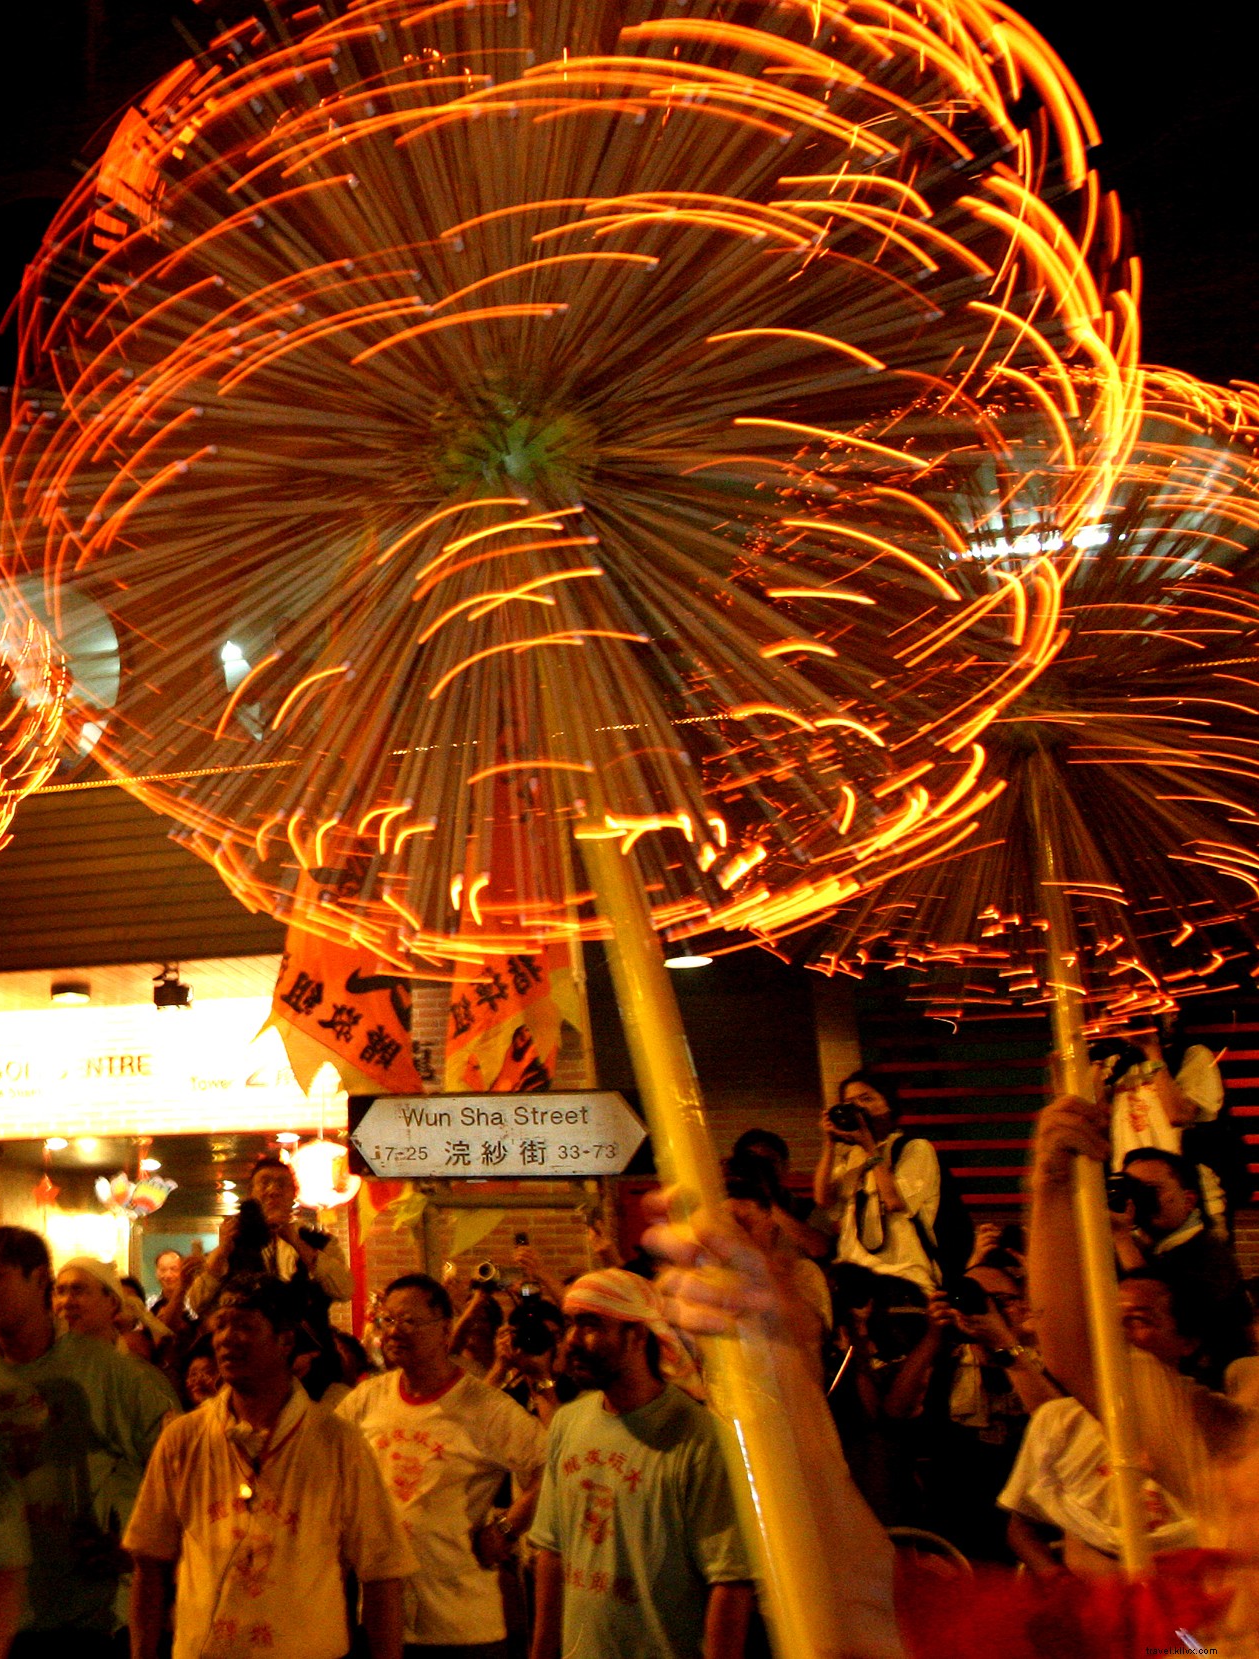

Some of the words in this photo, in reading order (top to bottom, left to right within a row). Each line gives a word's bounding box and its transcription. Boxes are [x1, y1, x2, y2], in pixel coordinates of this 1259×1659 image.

[402, 1108, 451, 1127] Wun
[461, 1107, 503, 1126] Sha
[514, 1106, 588, 1125] Street
[444, 1140, 546, 1166] 浣紗街
[558, 1144, 616, 1160] 33-73
